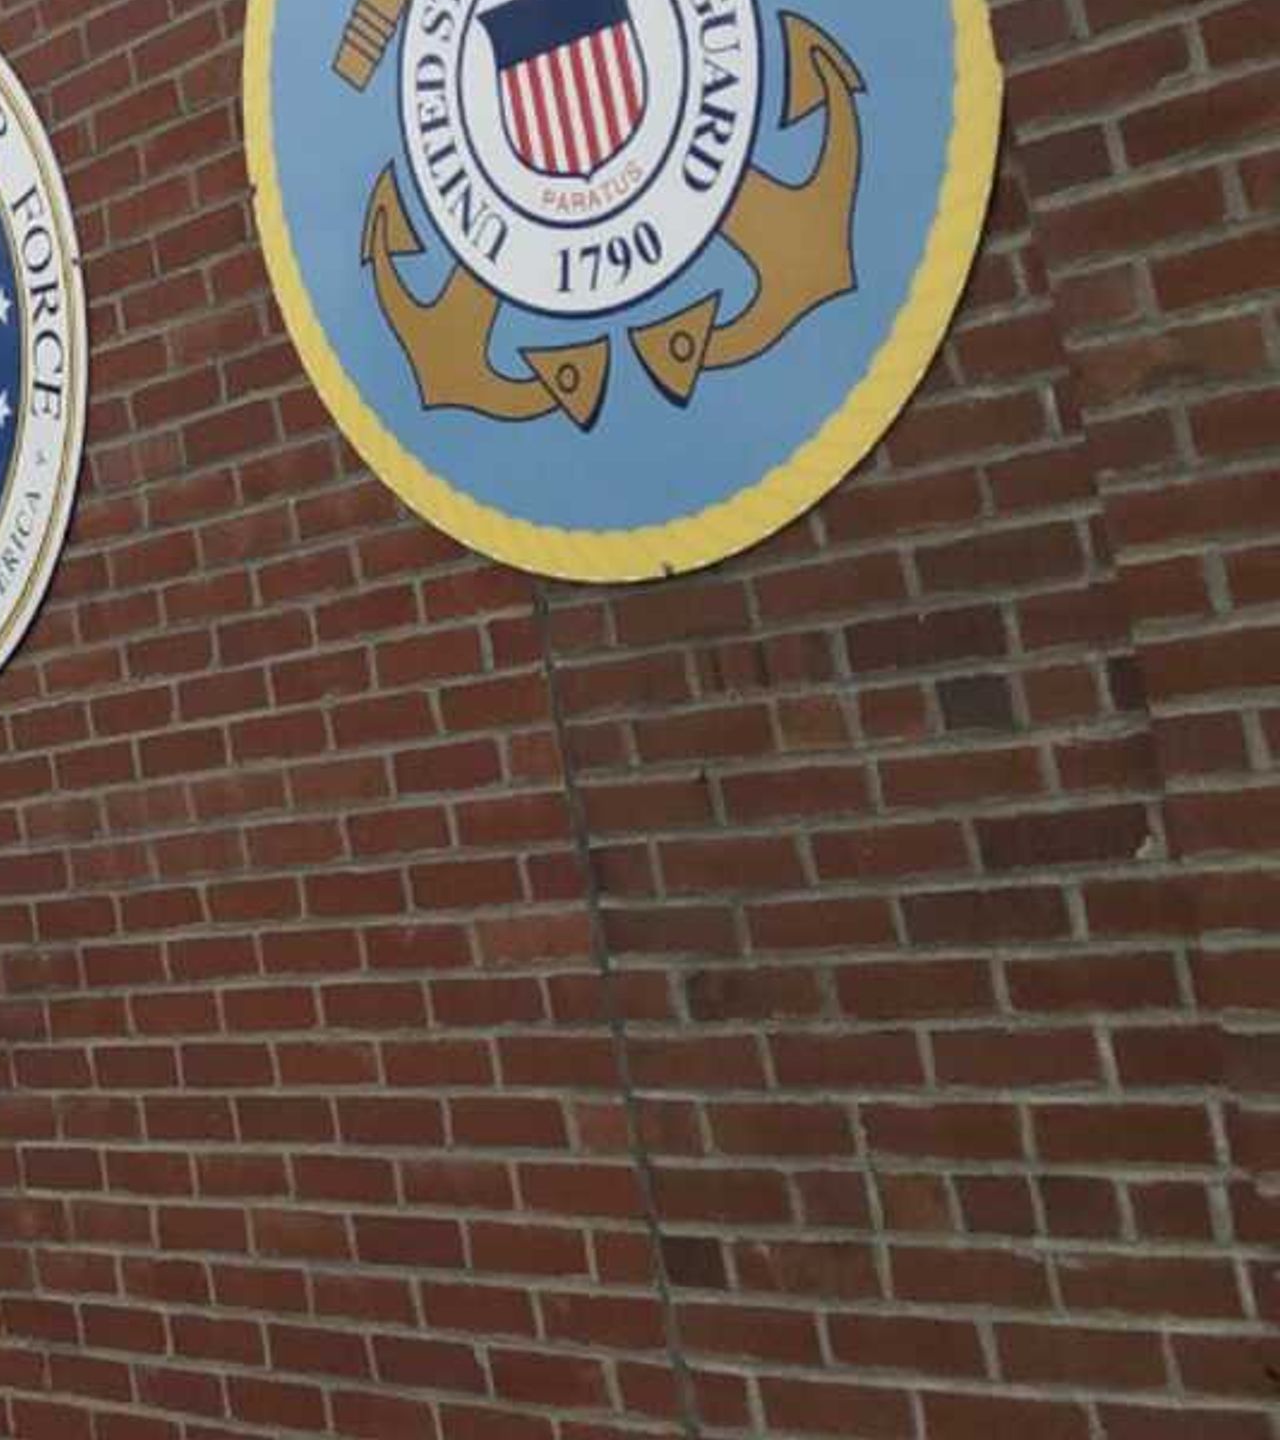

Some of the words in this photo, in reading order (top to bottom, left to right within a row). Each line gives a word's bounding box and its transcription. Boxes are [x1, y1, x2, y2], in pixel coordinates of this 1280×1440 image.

[417, 54, 508, 264] UNITED
[542, 159, 644, 213] PARATUS
[12, 185, 64, 421] FORCE
[557, 220, 662, 293] 1790
